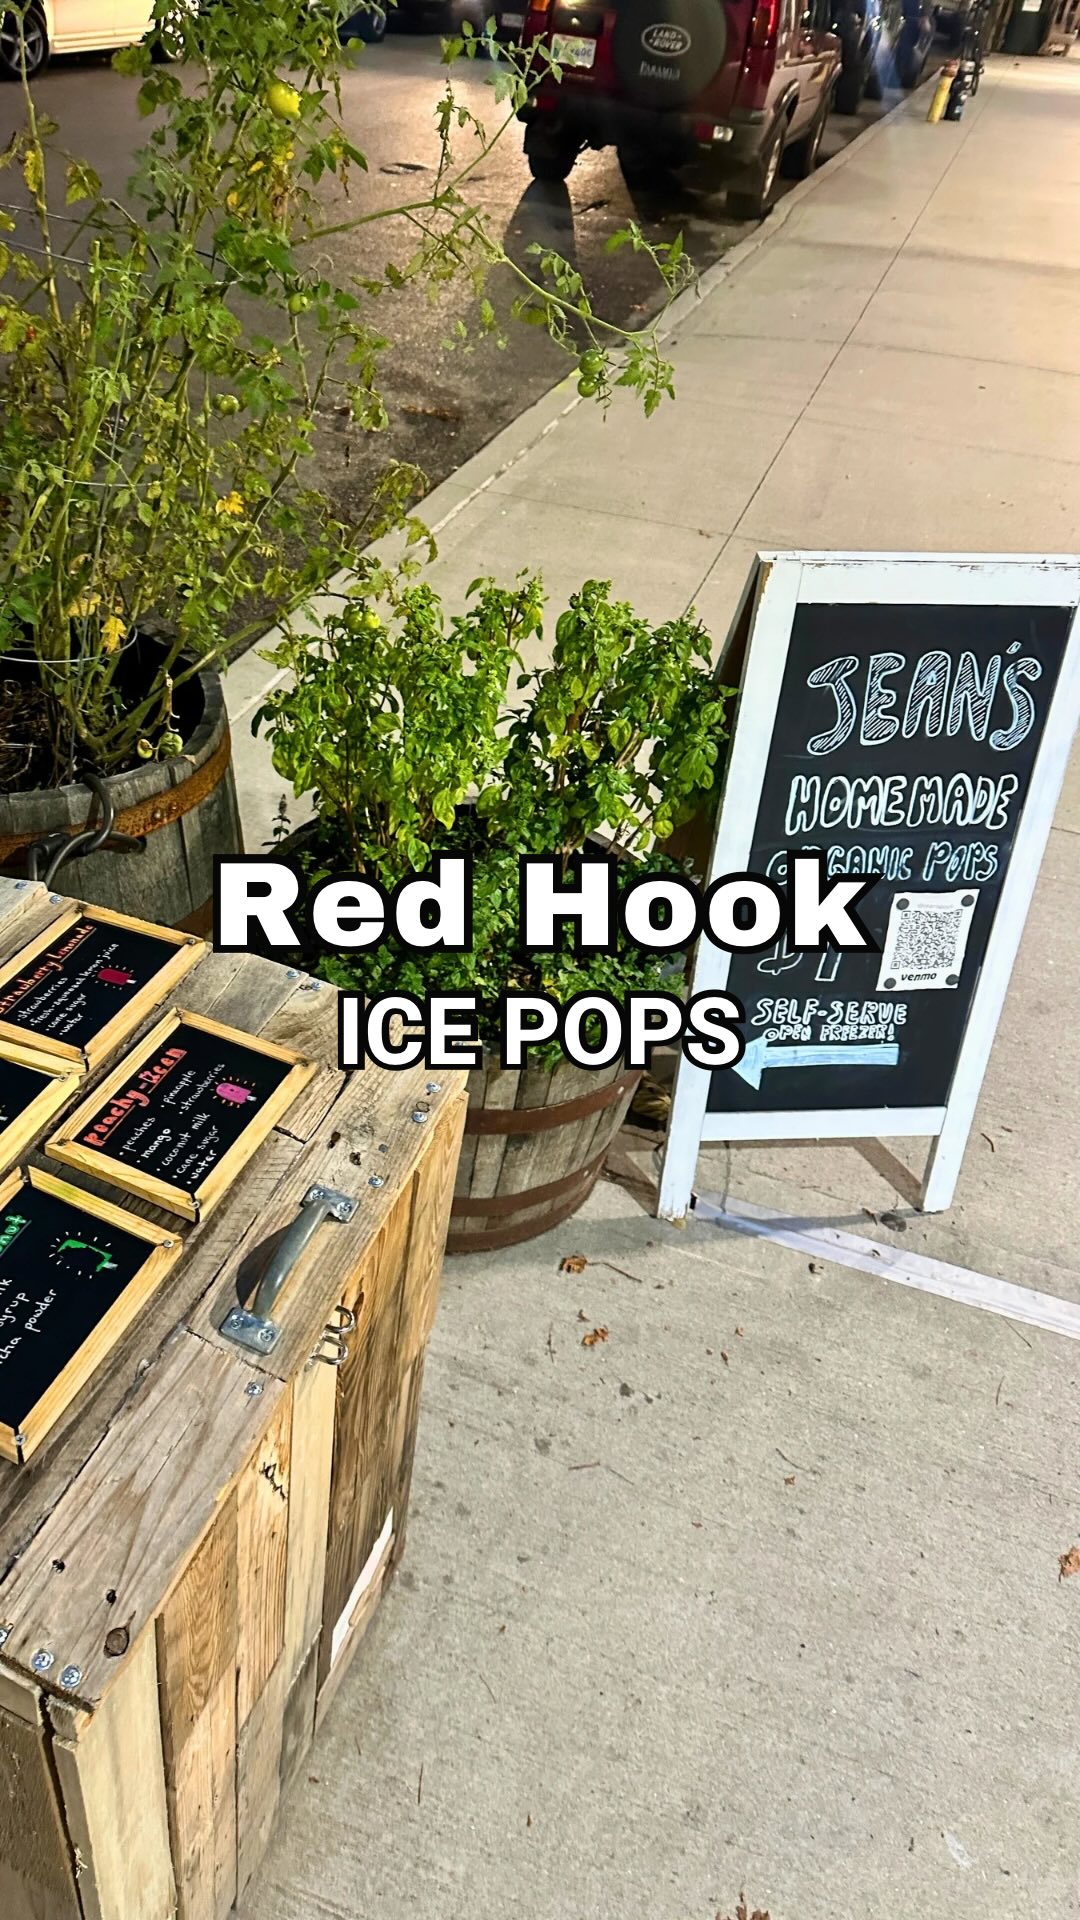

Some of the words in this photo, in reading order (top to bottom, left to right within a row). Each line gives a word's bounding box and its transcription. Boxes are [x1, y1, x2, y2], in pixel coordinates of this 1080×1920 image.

[652, 28, 677, 39] LAND
[653, 38, 683, 50] ROVER
[807, 641, 1042, 756] JEAN'S
[785, 773, 1019, 836] HOMEMADE
[922, 841, 999, 882] POPS
[79, 959, 103, 977] lemon
[96, 943, 119, 960] juice
[901, 972, 937, 982] venmo
[18, 977, 68, 1018] strawberries
[48, 1012, 68, 1028] cane
[66, 993, 87, 1011] sugar
[751, 997, 908, 1026] SELF-SERVE
[61, 1013, 84, 1033] water
[763, 1023, 811, 1042] OPEN
[820, 1023, 895, 1041] FREEZER!
[163, 1070, 196, 1105] pineapple
[180, 1063, 226, 1111] strawberries
[122, 1117, 155, 1152] peaches
[141, 1128, 172, 1159] mango
[161, 1132, 192, 1166] coconut
[191, 1112, 211, 1130] milk
[176, 1153, 198, 1174] cane
[197, 1125, 220, 1150] sugar
[190, 1149, 217, 1180] water
[24, 1288, 57, 1333] powder
